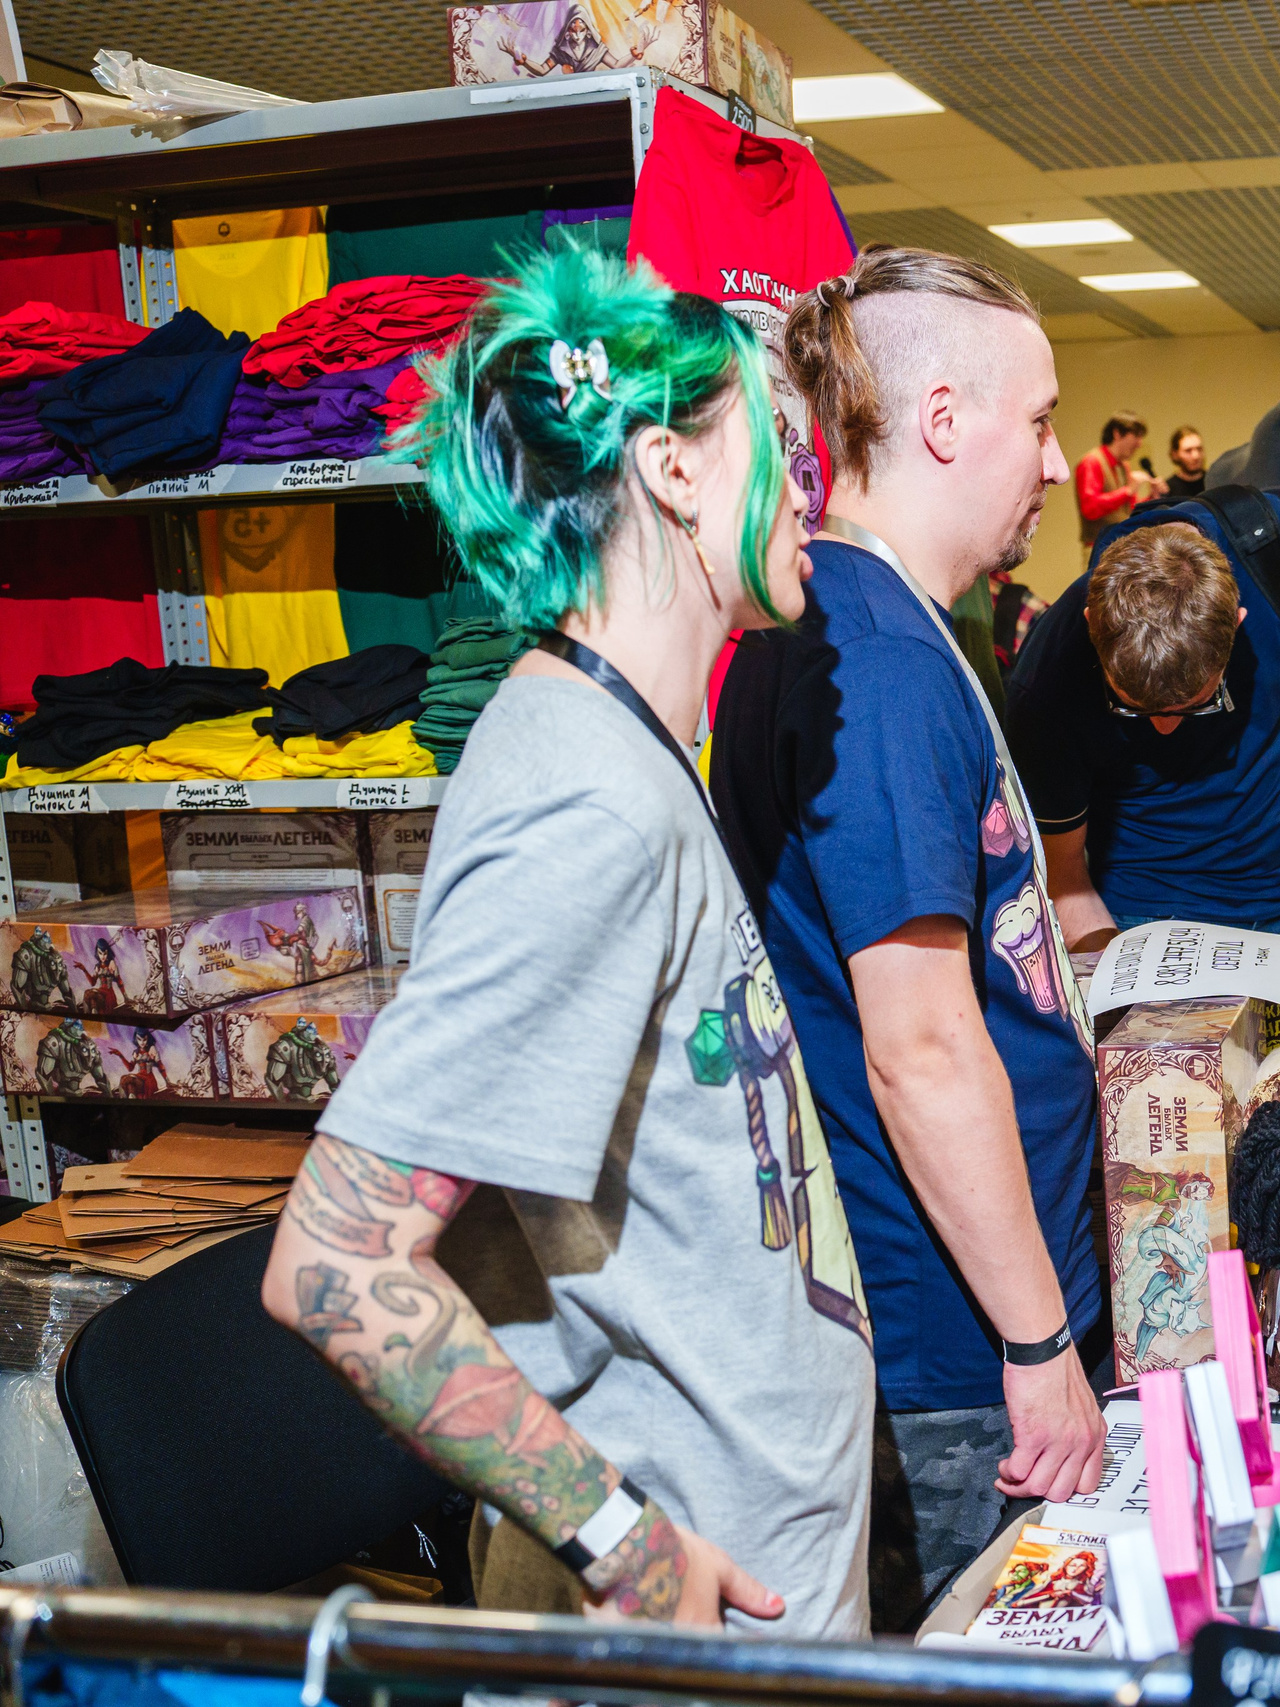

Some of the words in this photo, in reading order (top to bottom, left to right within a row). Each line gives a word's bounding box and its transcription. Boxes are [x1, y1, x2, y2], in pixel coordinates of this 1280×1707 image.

[6, 829, 53, 844] ЕГЕНД
[185, 831, 239, 846] ЗЕМЛИ
[273, 831, 336, 846] ЛЕГЕНД
[197, 940, 232, 956] ЗЕМЛИ
[197, 958, 236, 975] ЛЕГЕНД
[1147, 1091, 1163, 1157] ЛЕГЕНД
[1163, 1107, 1173, 1141] БЫЛЫХ
[1174, 1096, 1189, 1152] ЗЕМЛИ
[1078, 1534, 1108, 1545] СКИД
[986, 1606, 1102, 1626] ЗЕМЛИ
[1000, 1626, 1067, 1639] БЫЛЫХ
